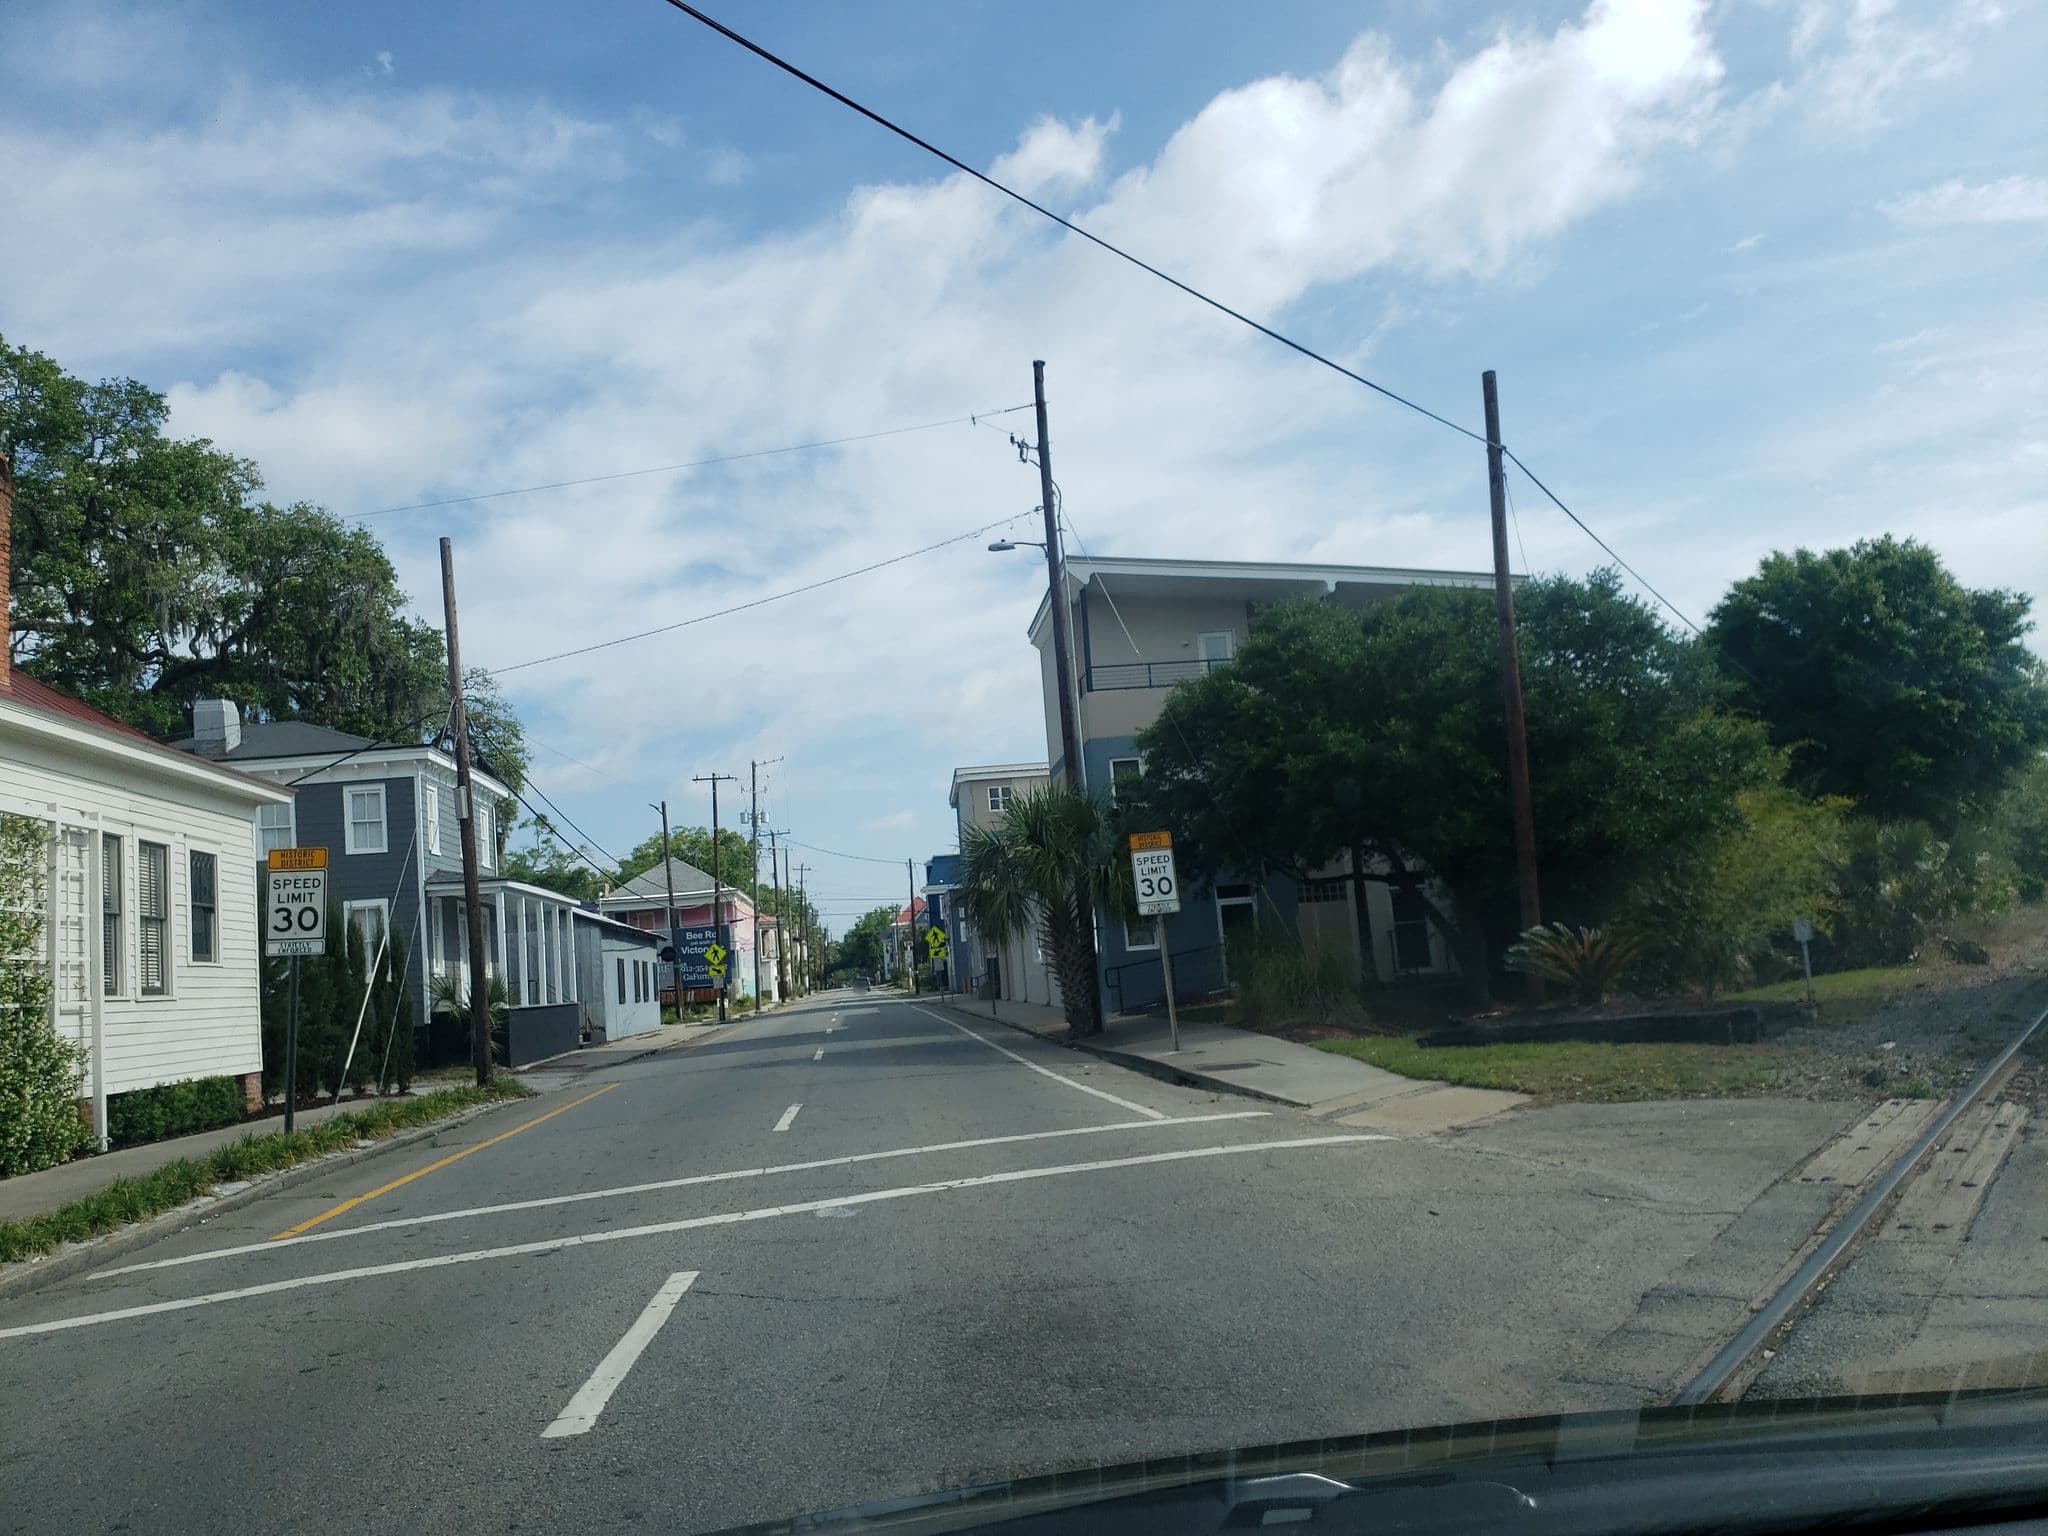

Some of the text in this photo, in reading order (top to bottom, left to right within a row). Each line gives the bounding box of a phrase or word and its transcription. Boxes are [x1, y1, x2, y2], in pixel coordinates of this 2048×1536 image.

[280, 850, 315, 858] HISTORIC
[280, 859, 314, 867] DISTRICT
[1137, 855, 1170, 866] SPEED
[1141, 866, 1167, 876] LIMIT
[273, 878, 321, 890] SPEED
[1141, 877, 1172, 897] 30
[277, 892, 315, 904] LIMIT
[273, 906, 319, 932] 30
[686, 931, 703, 940] Bee
